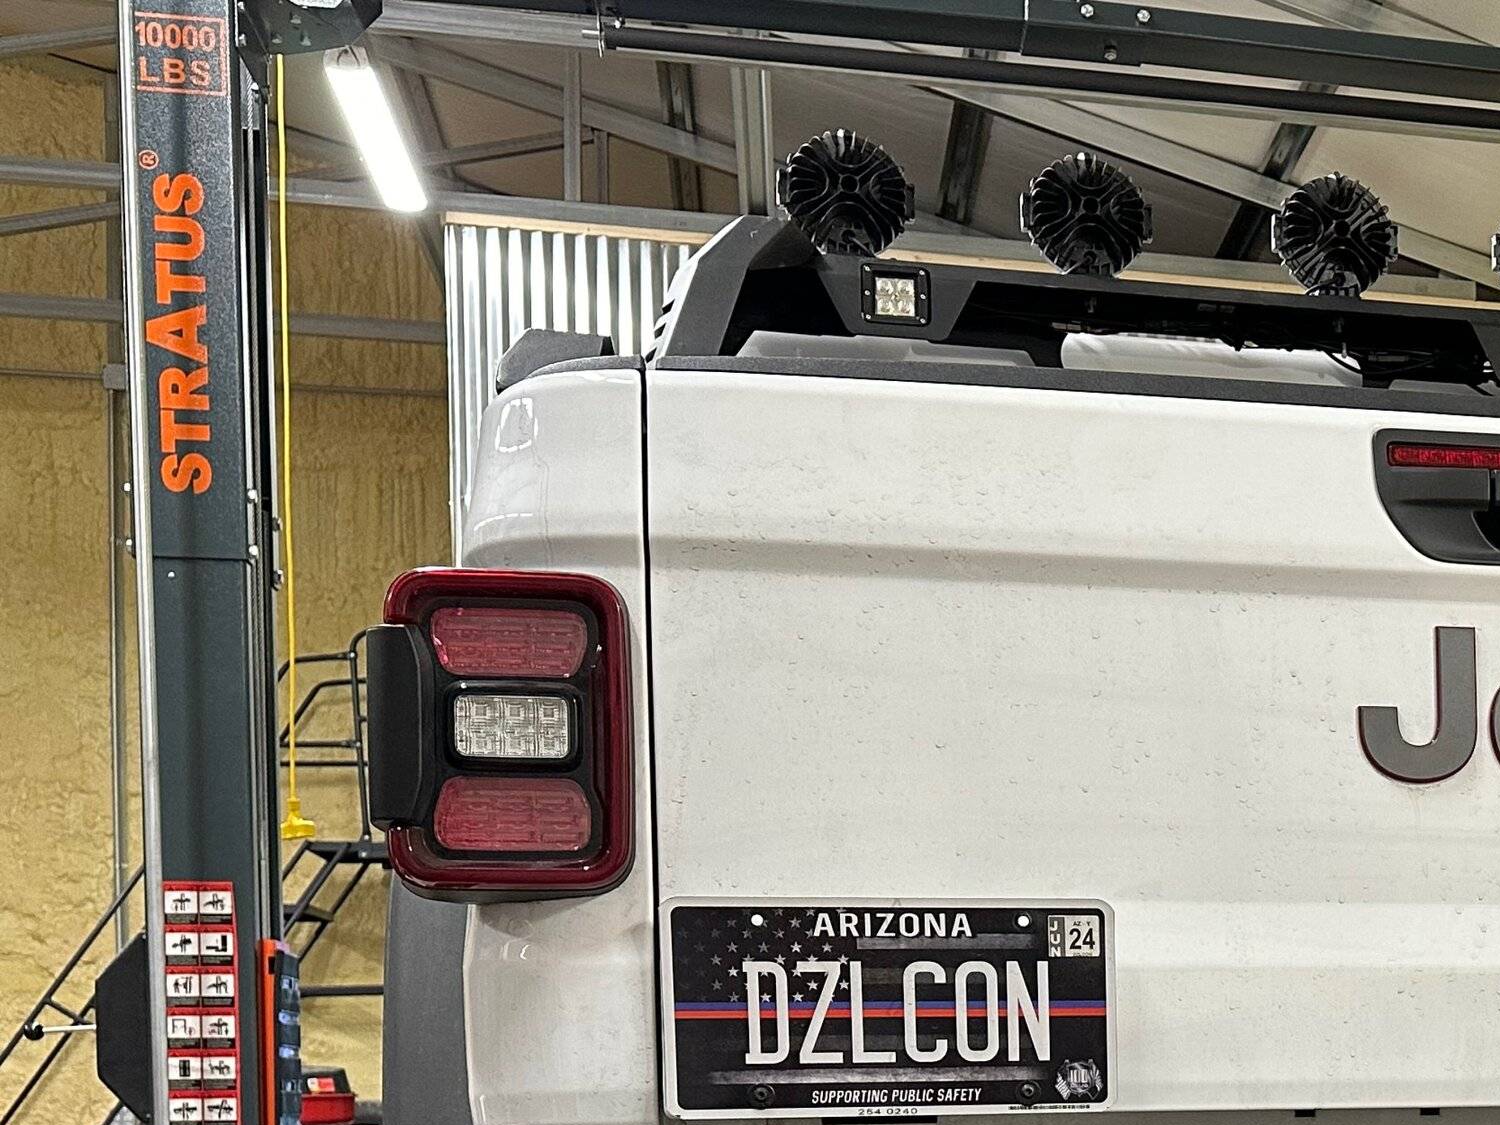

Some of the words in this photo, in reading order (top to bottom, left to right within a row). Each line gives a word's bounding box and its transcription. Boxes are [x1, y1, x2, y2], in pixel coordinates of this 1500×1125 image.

[134, 21, 216, 52] 10000
[138, 56, 211, 86] LBS
[146, 173, 213, 494] STRATUS
[813, 912, 973, 938] ARIZONA
[1049, 920, 1061, 957] JUN
[1069, 927, 1095, 950] 24
[742, 960, 1051, 1065] DZLCON
[811, 1090, 888, 1104] SUPPORTING
[891, 1088, 935, 1102] PUBLIC
[937, 1087, 982, 1102] SAFETY
